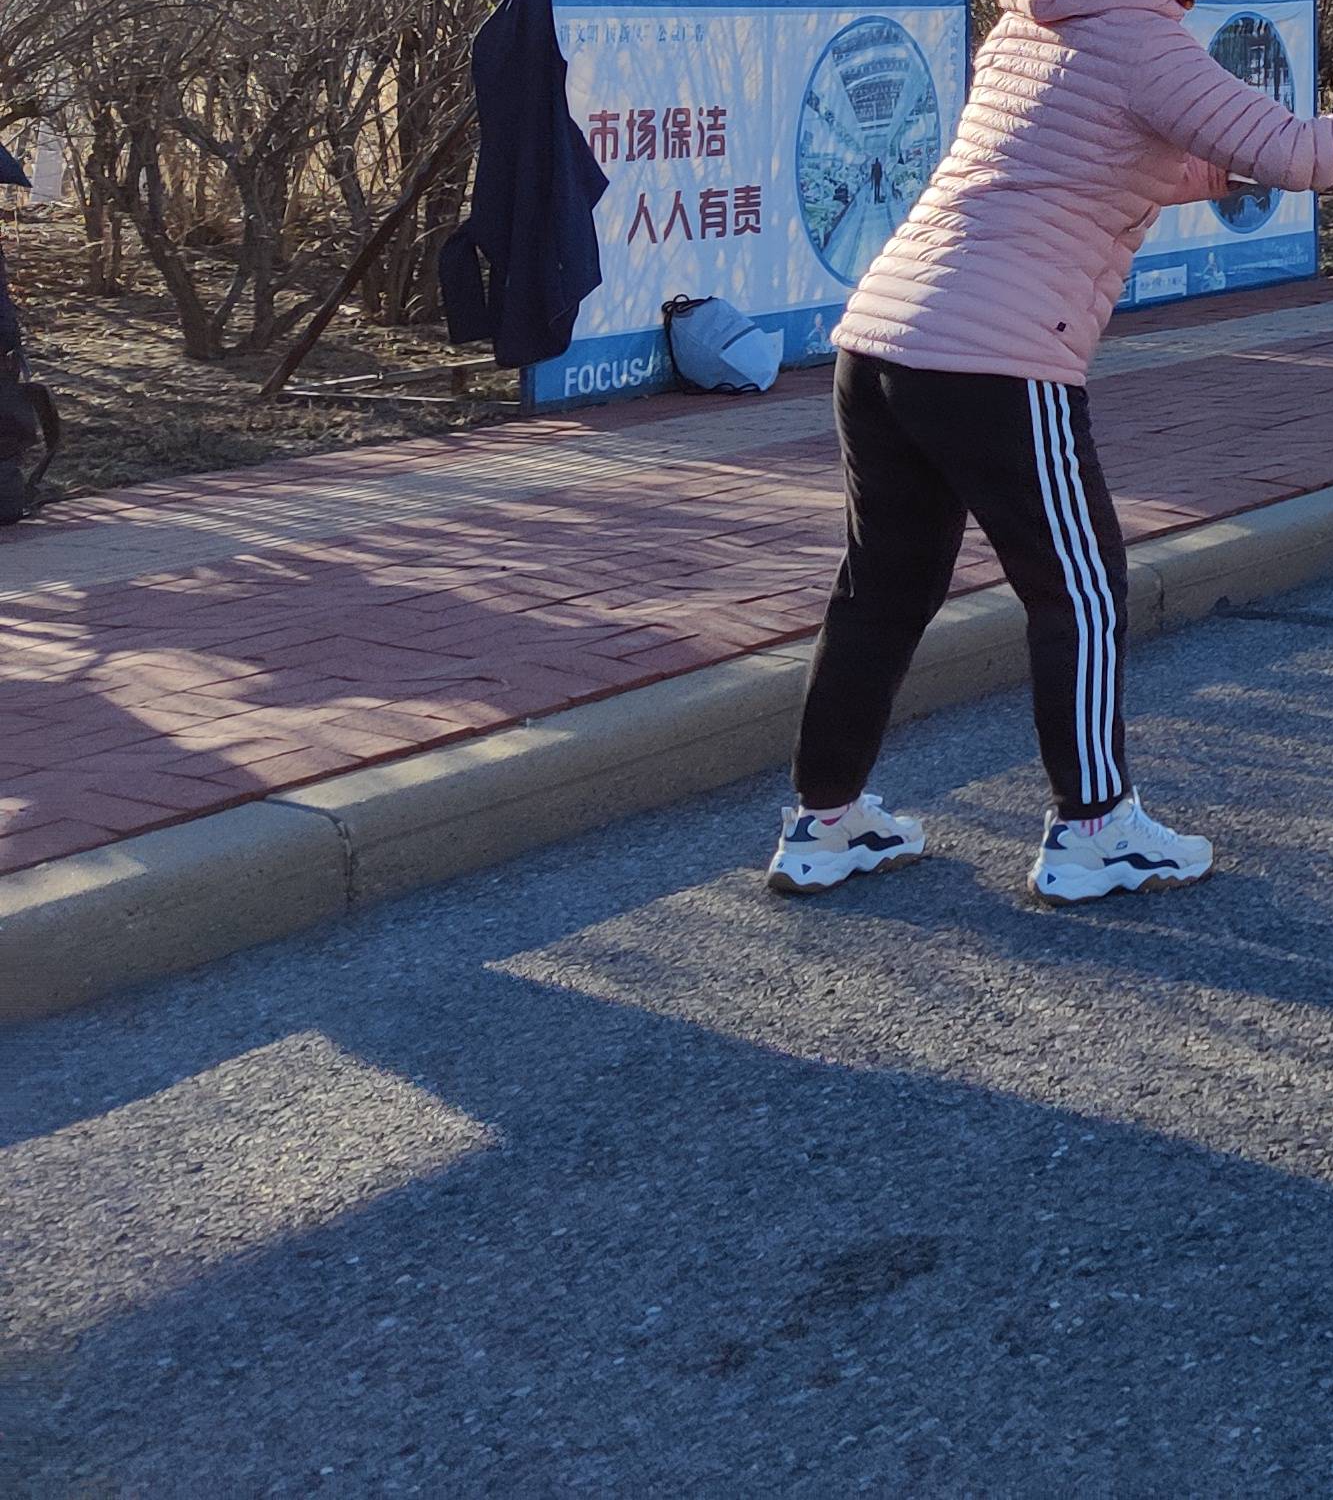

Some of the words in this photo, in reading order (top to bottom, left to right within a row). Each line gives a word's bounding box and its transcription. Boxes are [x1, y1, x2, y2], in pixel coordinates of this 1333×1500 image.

[588, 105, 727, 164] 市场保洁
[627, 185, 762, 246] 人人有责
